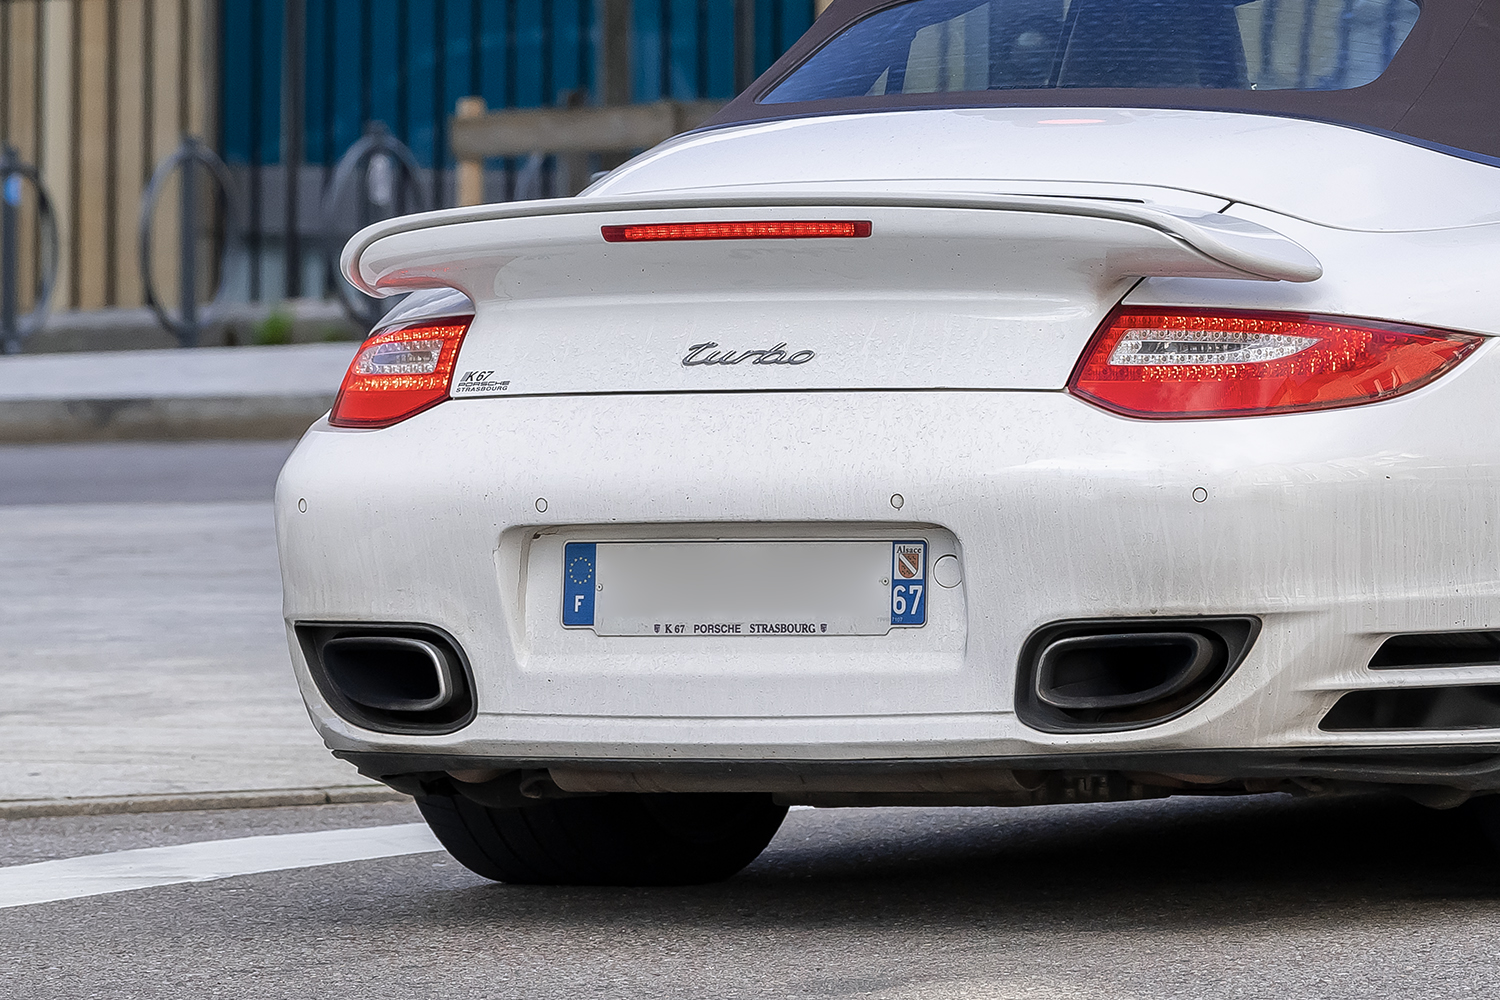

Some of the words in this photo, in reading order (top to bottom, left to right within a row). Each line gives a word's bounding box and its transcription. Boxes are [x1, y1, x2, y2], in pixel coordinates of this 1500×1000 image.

[896, 545, 922, 554] Alsace
[574, 594, 585, 613] F
[892, 585, 923, 615] 67
[664, 623, 673, 634] K
[674, 623, 686, 634] 67
[693, 623, 742, 634] PORSCHE
[749, 623, 817, 634] STRASBOURG
